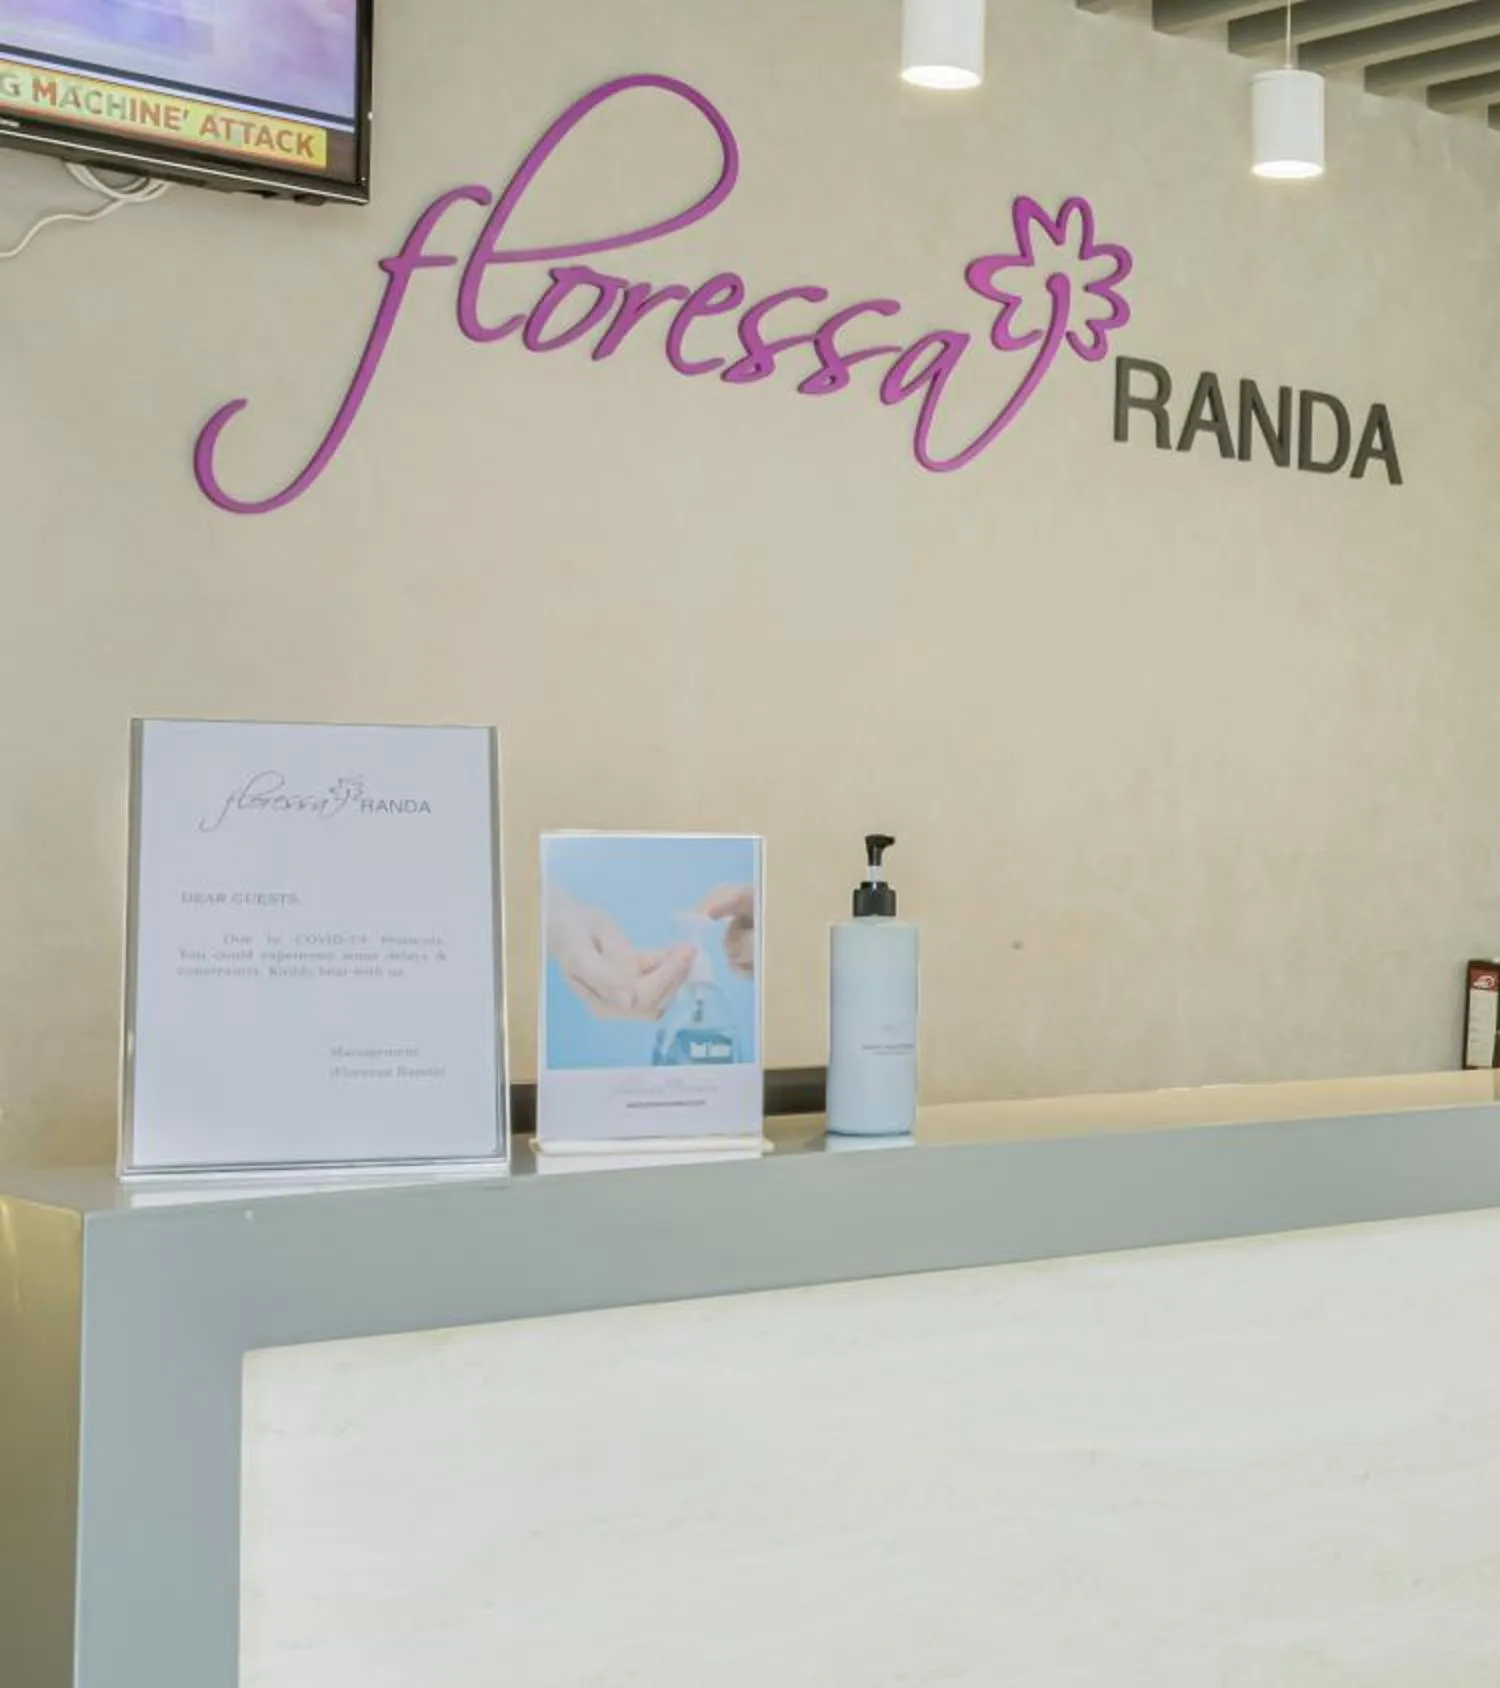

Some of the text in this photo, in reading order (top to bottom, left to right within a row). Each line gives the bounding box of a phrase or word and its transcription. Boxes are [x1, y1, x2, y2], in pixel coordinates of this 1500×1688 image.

[32, 75, 191, 131] MACHINE'
[198, 113, 315, 159] ATTACK
[193, 73, 1403, 514] floressa RANDA
[360, 797, 432, 815] RANDA
